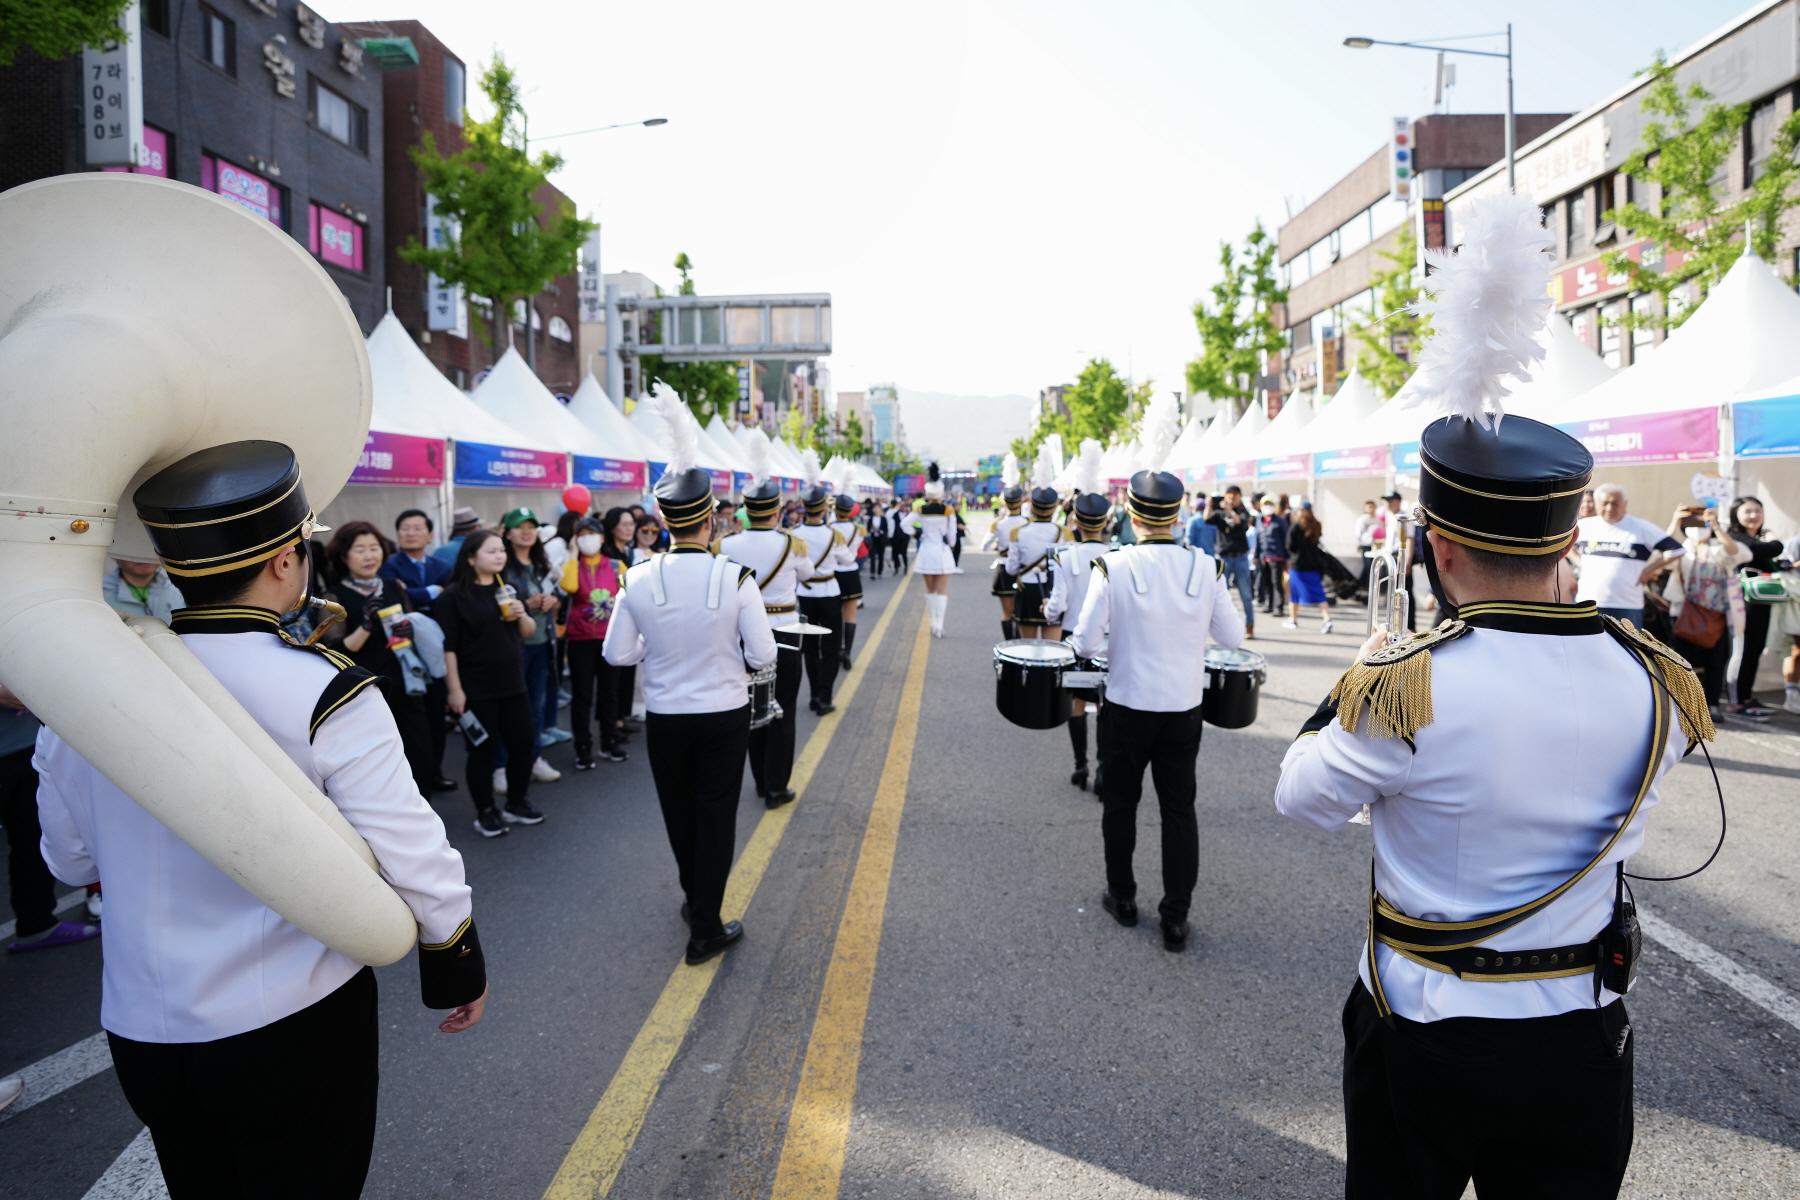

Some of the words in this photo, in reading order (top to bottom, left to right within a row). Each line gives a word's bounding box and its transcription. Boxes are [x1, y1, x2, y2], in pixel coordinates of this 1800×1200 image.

[92, 64, 105, 140] 7080
[106, 62, 123, 139] 라이브
[220, 167, 269, 206] 스포츠
